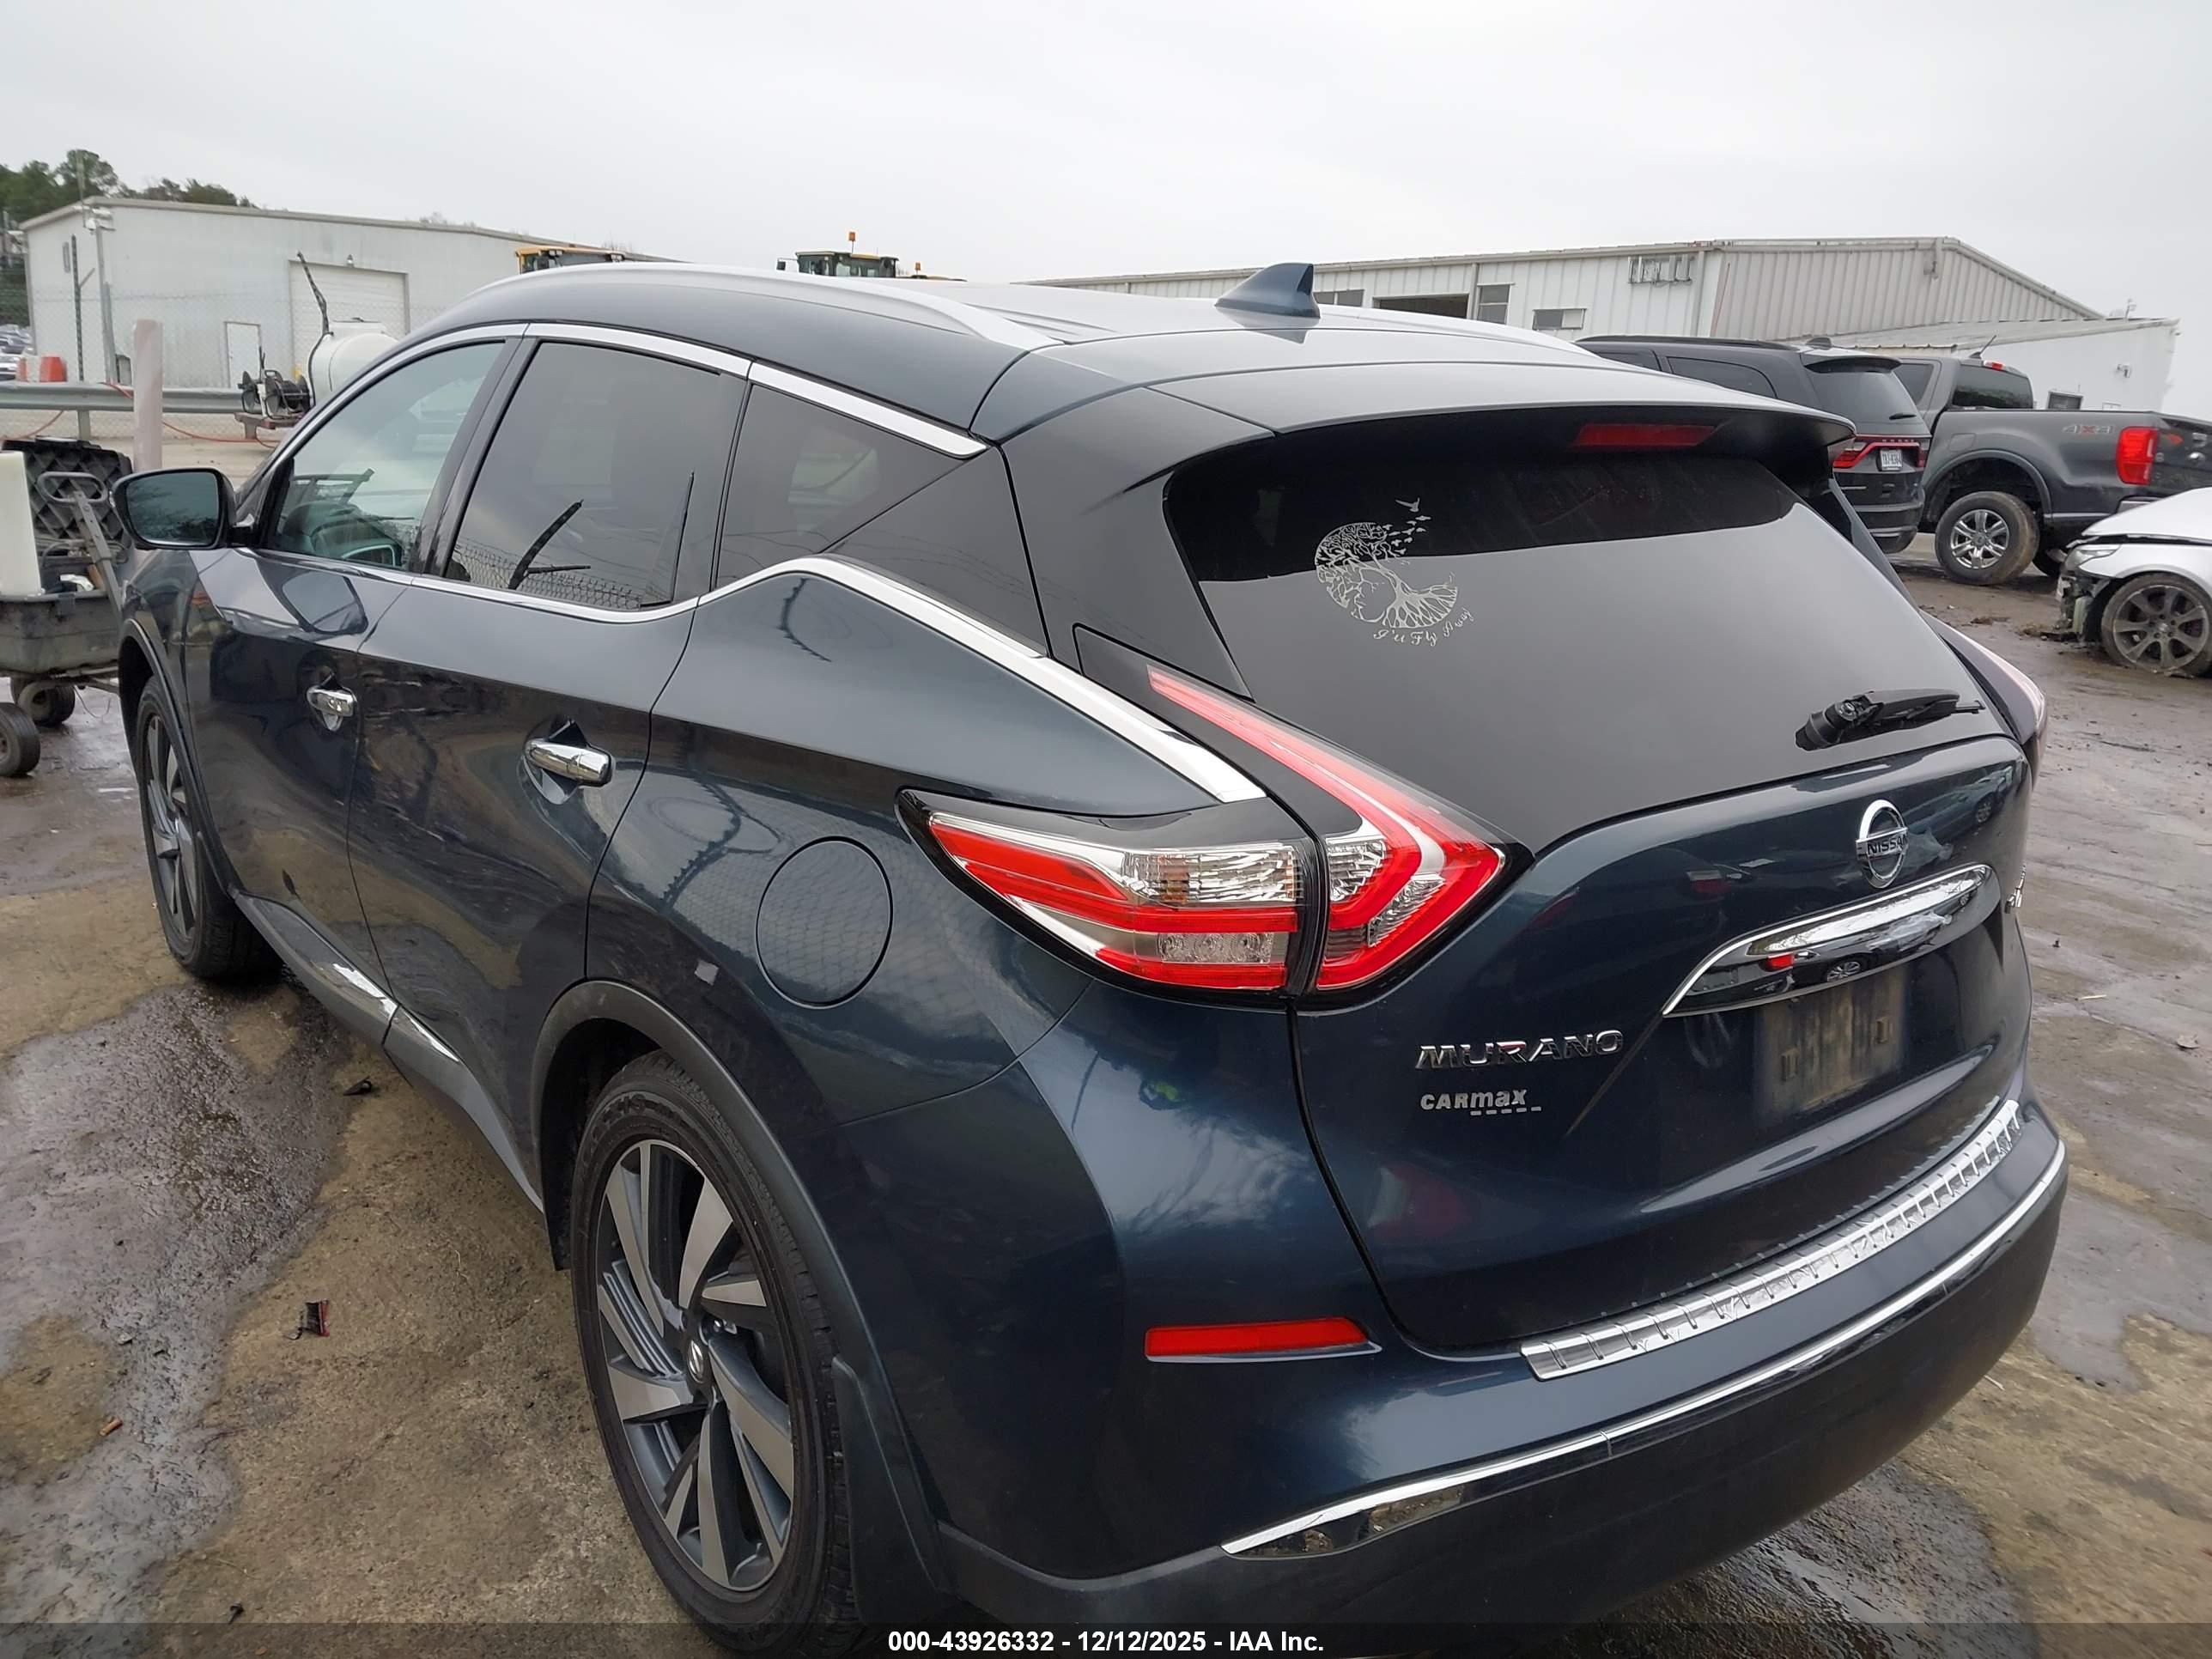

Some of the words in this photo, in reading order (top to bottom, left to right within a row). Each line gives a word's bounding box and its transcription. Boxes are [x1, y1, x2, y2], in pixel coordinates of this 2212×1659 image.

[1410, 630, 1437, 647] Fly
[1867, 832, 1908, 855] NISSAN
[1415, 1030, 1624, 1069] MURANO
